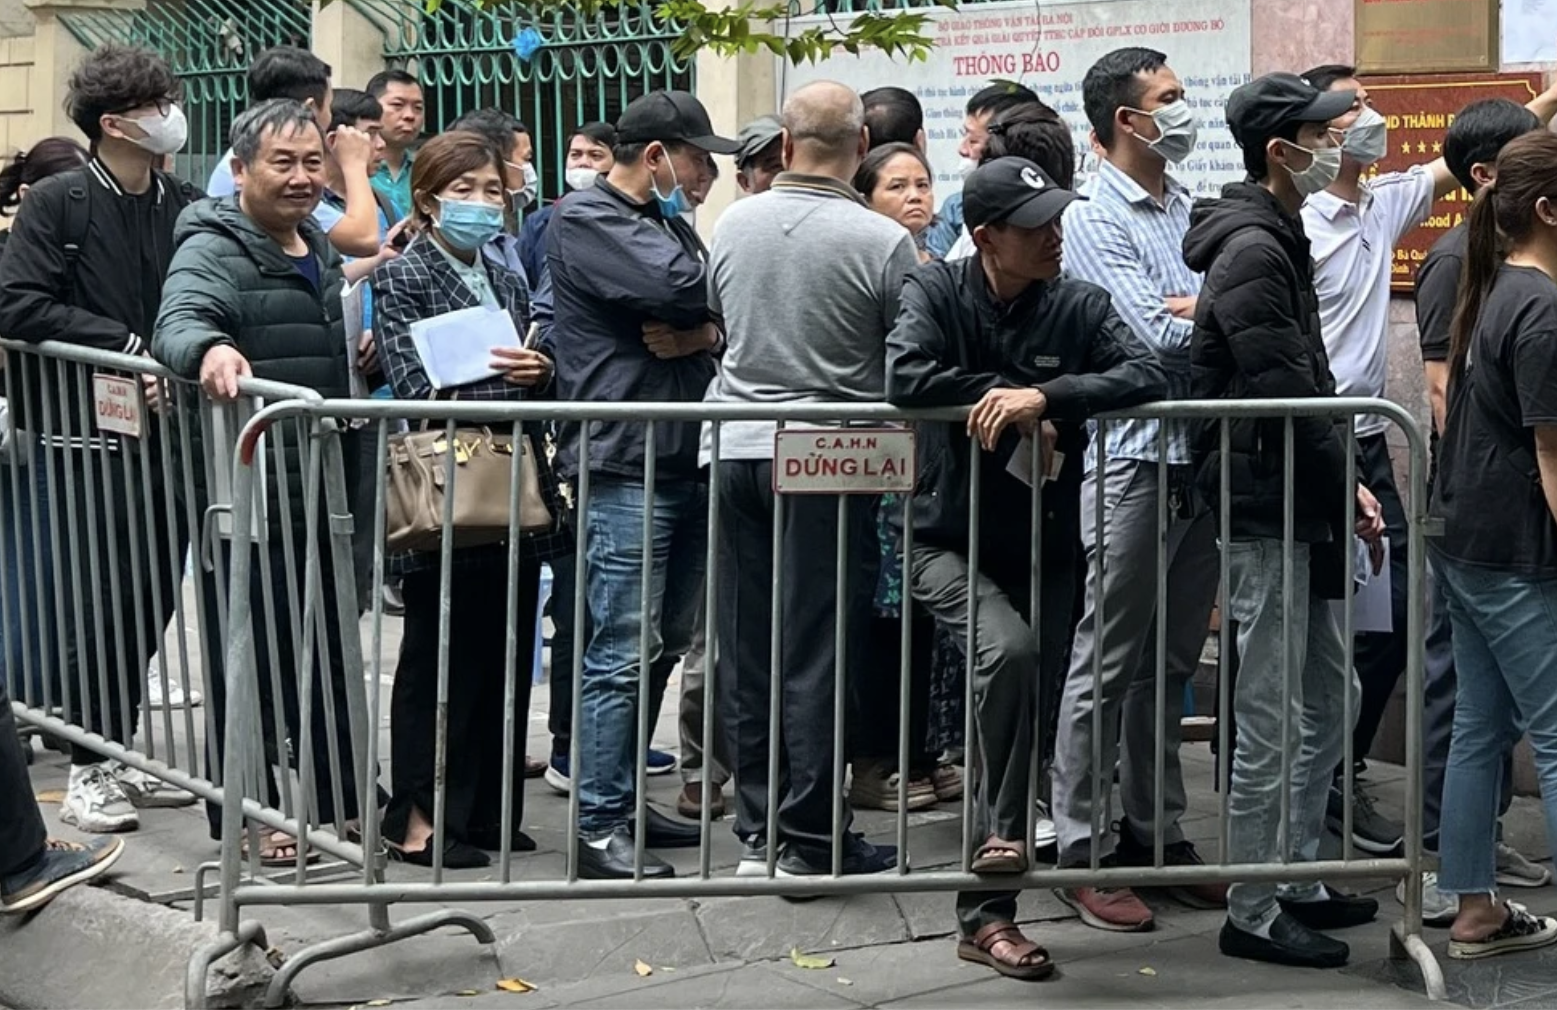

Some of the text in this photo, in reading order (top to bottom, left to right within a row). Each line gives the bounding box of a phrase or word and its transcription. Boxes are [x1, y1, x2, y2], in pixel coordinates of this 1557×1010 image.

[953, 47, 1060, 77] THÔNG BÁO
[1019, 166, 1045, 189] C
[785, 452, 907, 481] DỪNG LẠI
